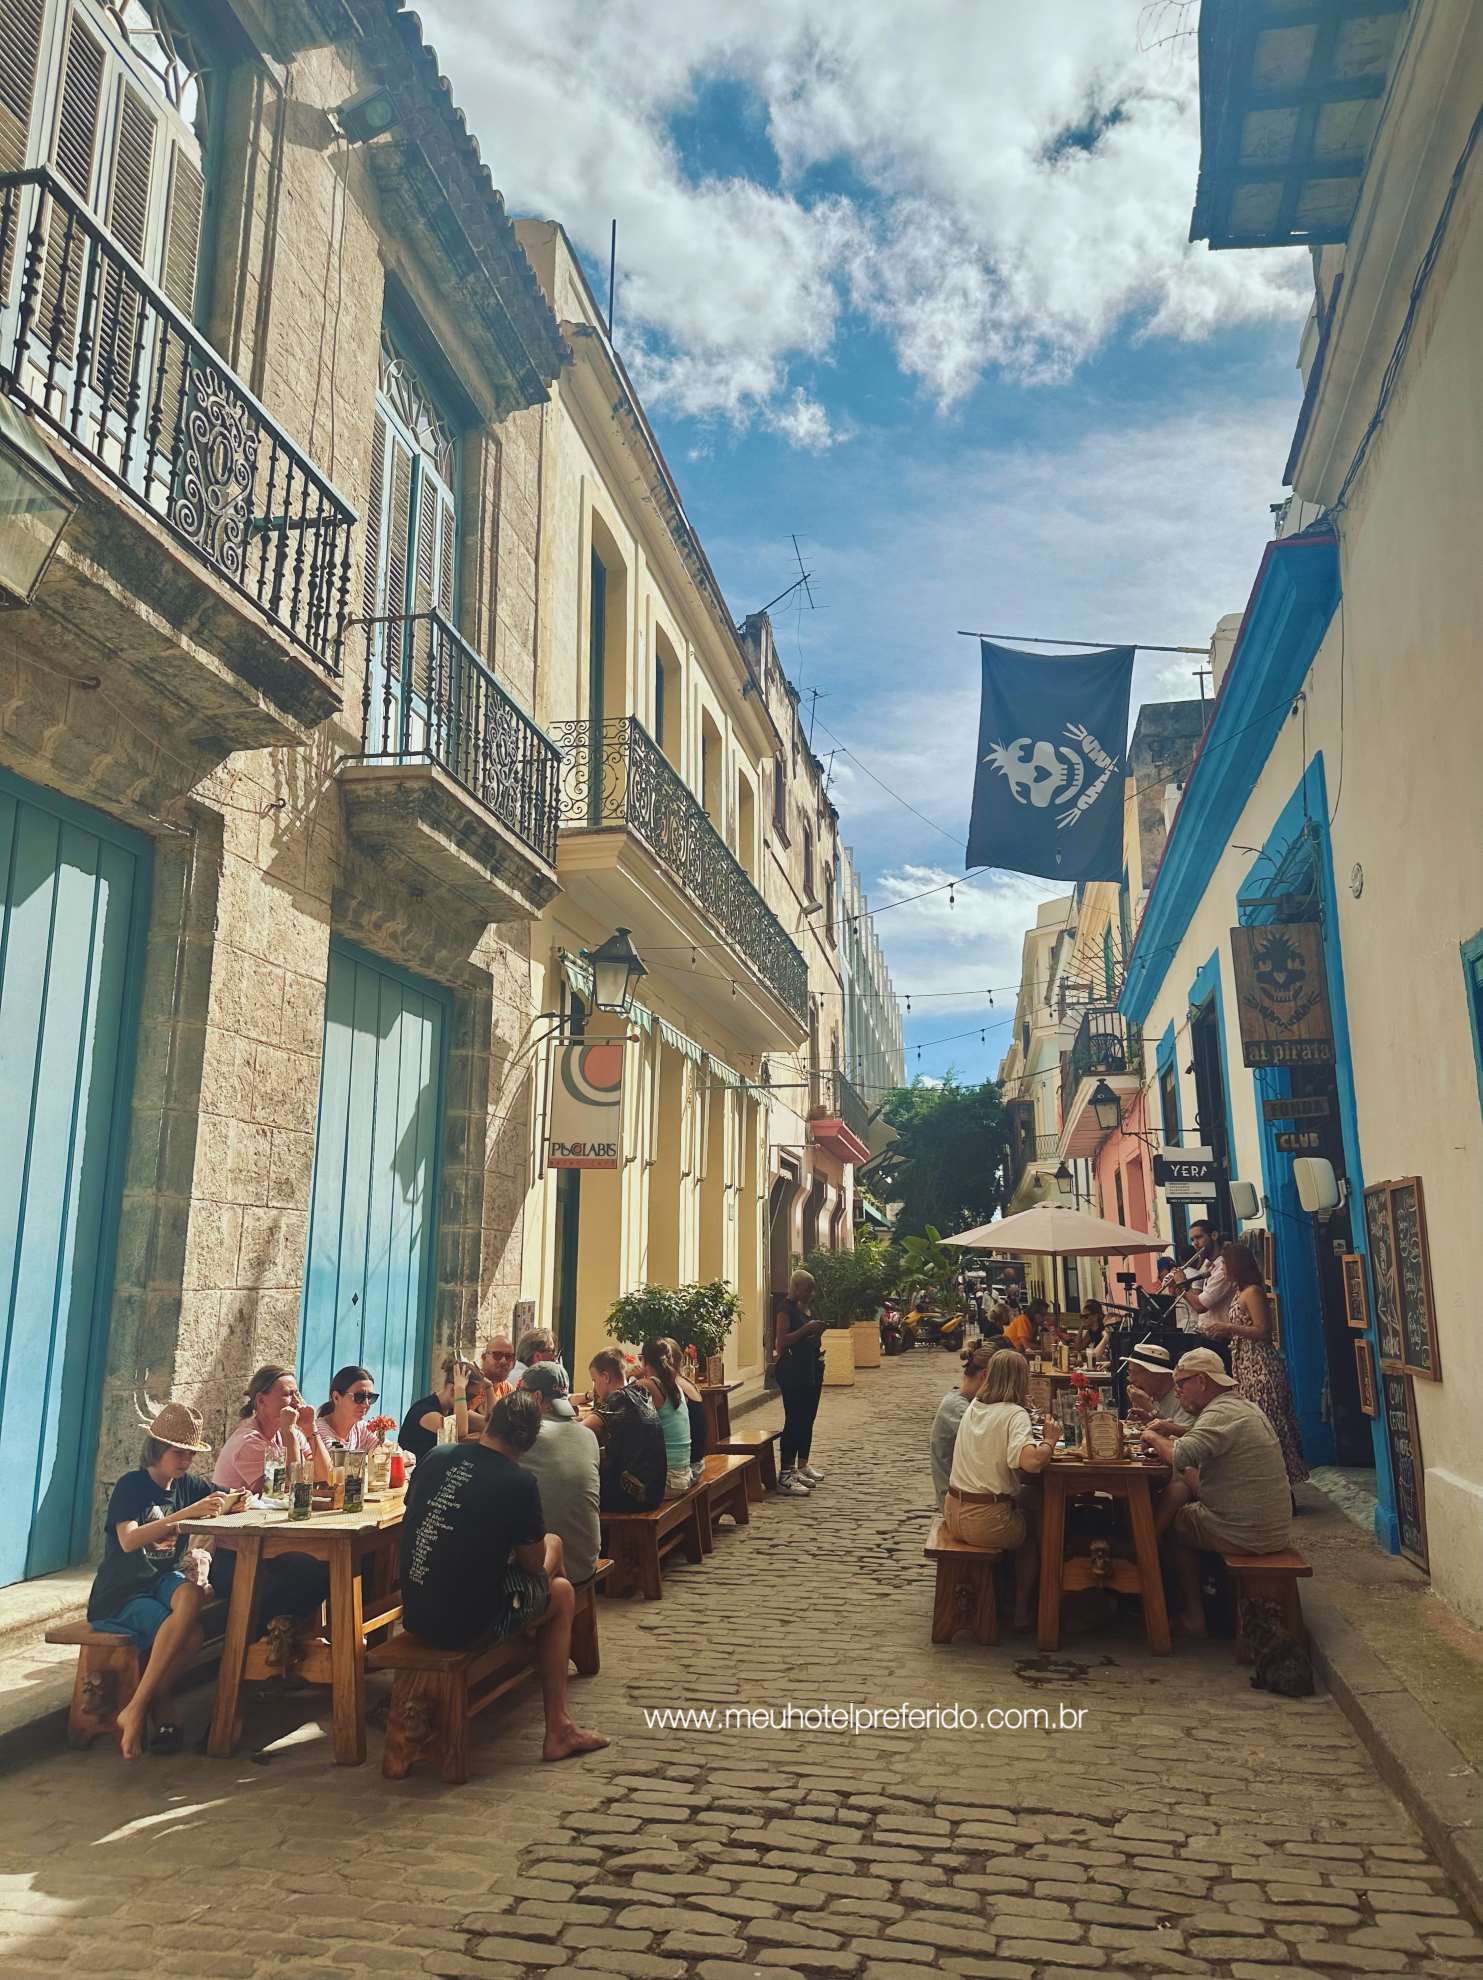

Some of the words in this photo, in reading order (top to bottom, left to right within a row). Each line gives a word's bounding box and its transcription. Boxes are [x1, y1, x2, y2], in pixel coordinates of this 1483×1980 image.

[1272, 1041, 1330, 1065] pirata
[1280, 1132, 1320, 1148] CLUB
[1170, 1165, 1208, 1177] YERA
